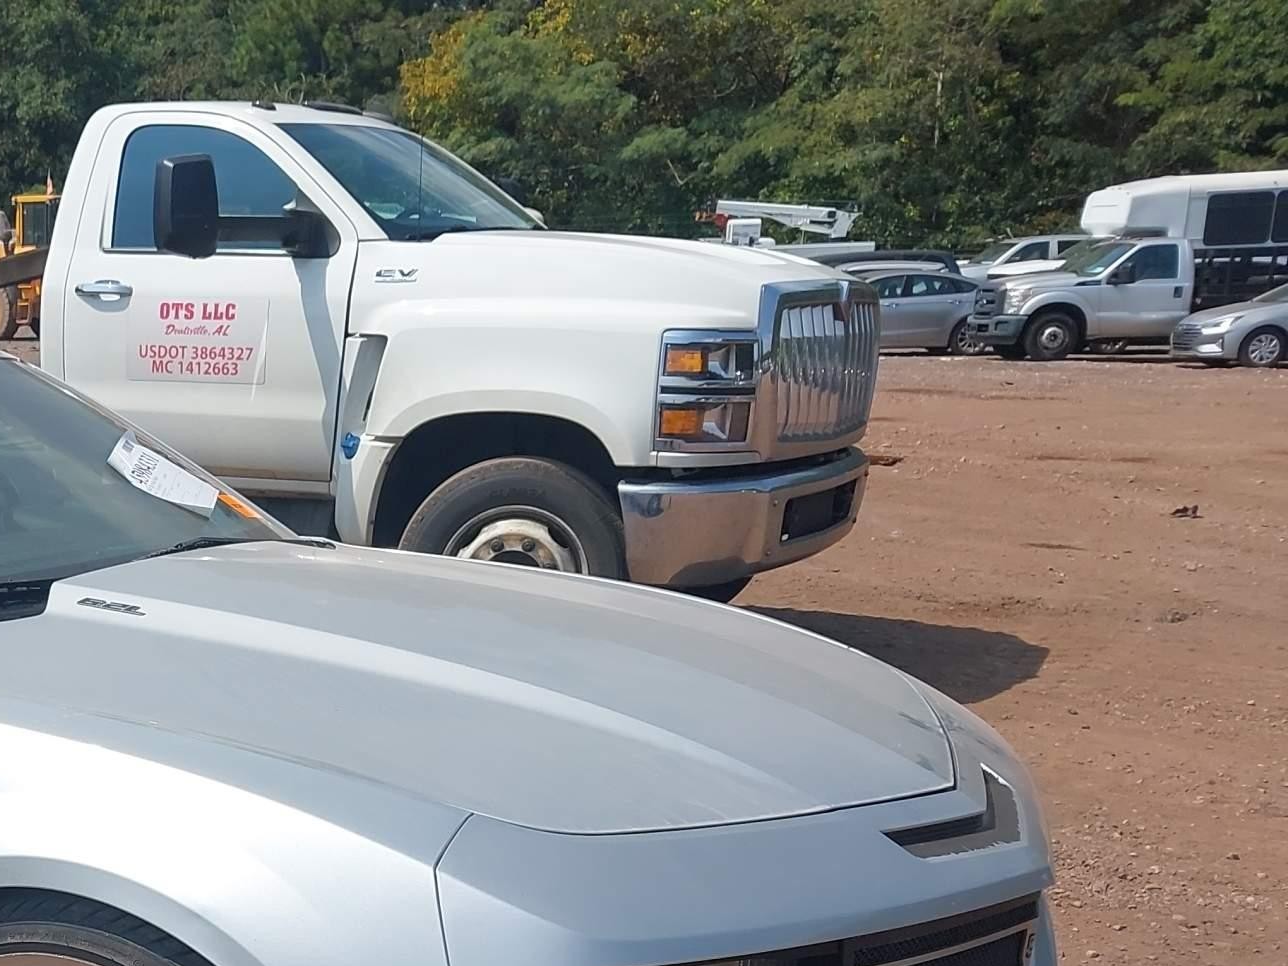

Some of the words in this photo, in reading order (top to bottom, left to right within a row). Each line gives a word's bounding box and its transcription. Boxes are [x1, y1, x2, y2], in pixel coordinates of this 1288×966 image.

[159, 302, 195, 321] OTS
[201, 303, 237, 321] LLC
[212, 325, 231, 337] AL
[138, 344, 188, 360] USDOT
[190, 346, 254, 361] 3864327
[151, 360, 173, 374] MC
[177, 361, 239, 376] 1412663
